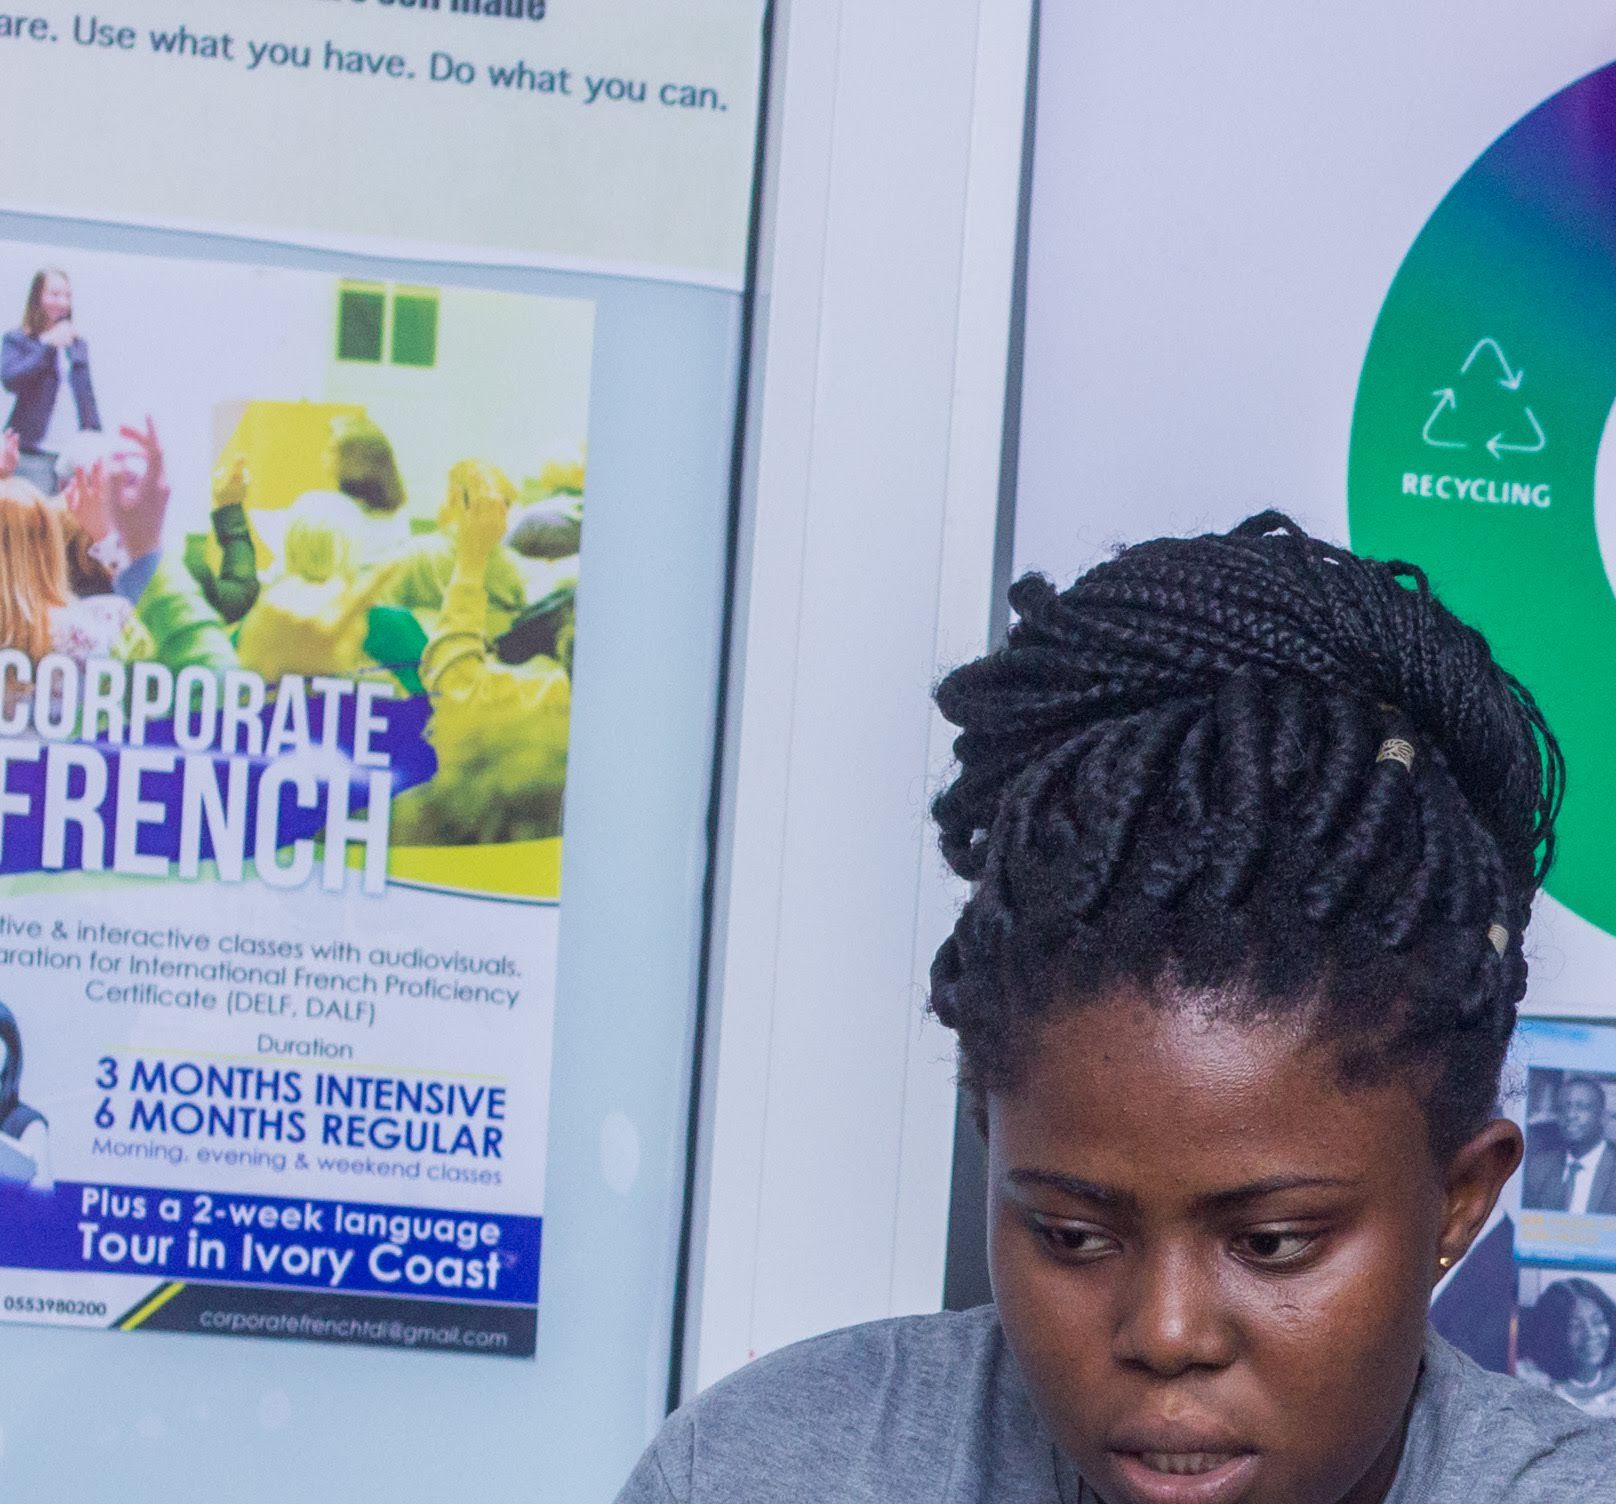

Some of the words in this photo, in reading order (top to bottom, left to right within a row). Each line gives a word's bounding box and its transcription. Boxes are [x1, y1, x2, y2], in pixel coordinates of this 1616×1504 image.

[73, 14, 136, 49] Use
[149, 25, 234, 62] what
[246, 42, 311, 70] you
[323, 40, 416, 80] have.
[429, 51, 476, 84] Do
[487, 60, 573, 96] what
[584, 75, 647, 105] you
[658, 82, 729, 113] can.
[1402, 472, 1551, 508] RECYCLING
[0, 648, 395, 768] CORPORATE
[0, 739, 394, 896] FRENCH
[50, 919, 68, 940] &
[77, 918, 211, 954] interactive
[217, 934, 304, 960] classes
[310, 940, 362, 966] with
[368, 945, 523, 979] audiovisuals.
[85, 979, 217, 1012] Certificate
[226, 989, 298, 1020] (DELF,
[305, 996, 377, 1028] DALF)
[89, 950, 123, 974] for
[129, 952, 287, 987] International
[294, 966, 378, 996] French
[384, 974, 521, 1010] Proficiency
[256, 1032, 354, 1060] Duration
[95, 1057, 119, 1090] 3
[130, 1060, 302, 1104] MONTHS
[315, 1074, 507, 1120] INTENSIVE
[94, 1099, 116, 1130] 6
[129, 1102, 307, 1144] MONTHS
[322, 1116, 503, 1158] REGULAR
[91, 1136, 189, 1164] Morning,
[197, 1147, 287, 1172] evening
[294, 1152, 310, 1171] &
[317, 1154, 421, 1180] weekend
[426, 1160, 503, 1187] classes
[80, 1186, 147, 1220] Plus
[158, 1198, 181, 1221] a
[192, 1196, 323, 1233] 2-week
[334, 1207, 500, 1247] language
[78, 1222, 174, 1266] Tour
[186, 1229, 226, 1270] in
[242, 1235, 354, 1285] Ivory
[368, 1242, 500, 1291] Coast
